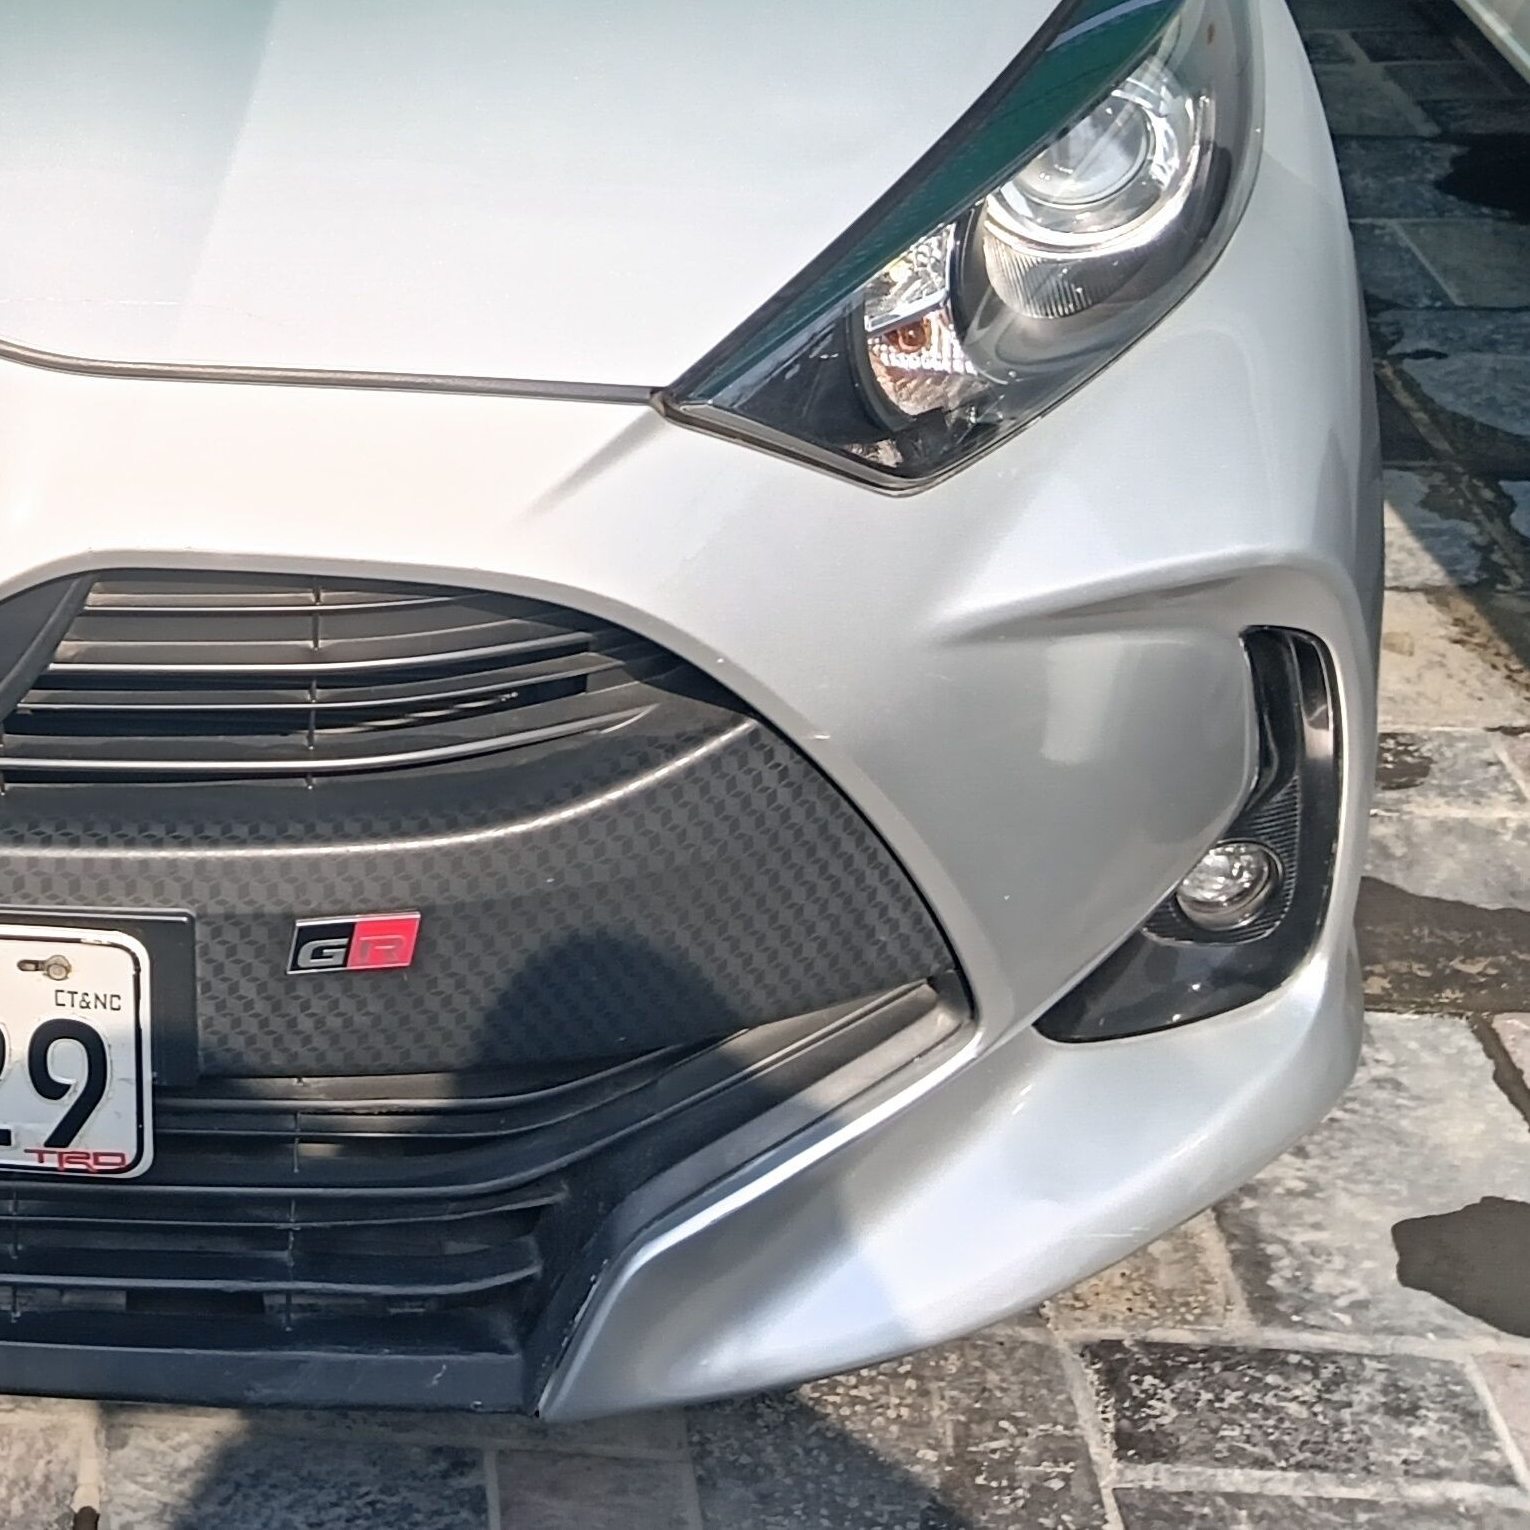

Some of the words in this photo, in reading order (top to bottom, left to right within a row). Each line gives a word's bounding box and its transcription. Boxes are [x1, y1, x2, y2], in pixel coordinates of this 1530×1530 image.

[297, 934, 408, 969] GR
[54, 989, 122, 1011] CT&NC
[23, 1148, 127, 1174] TRD
